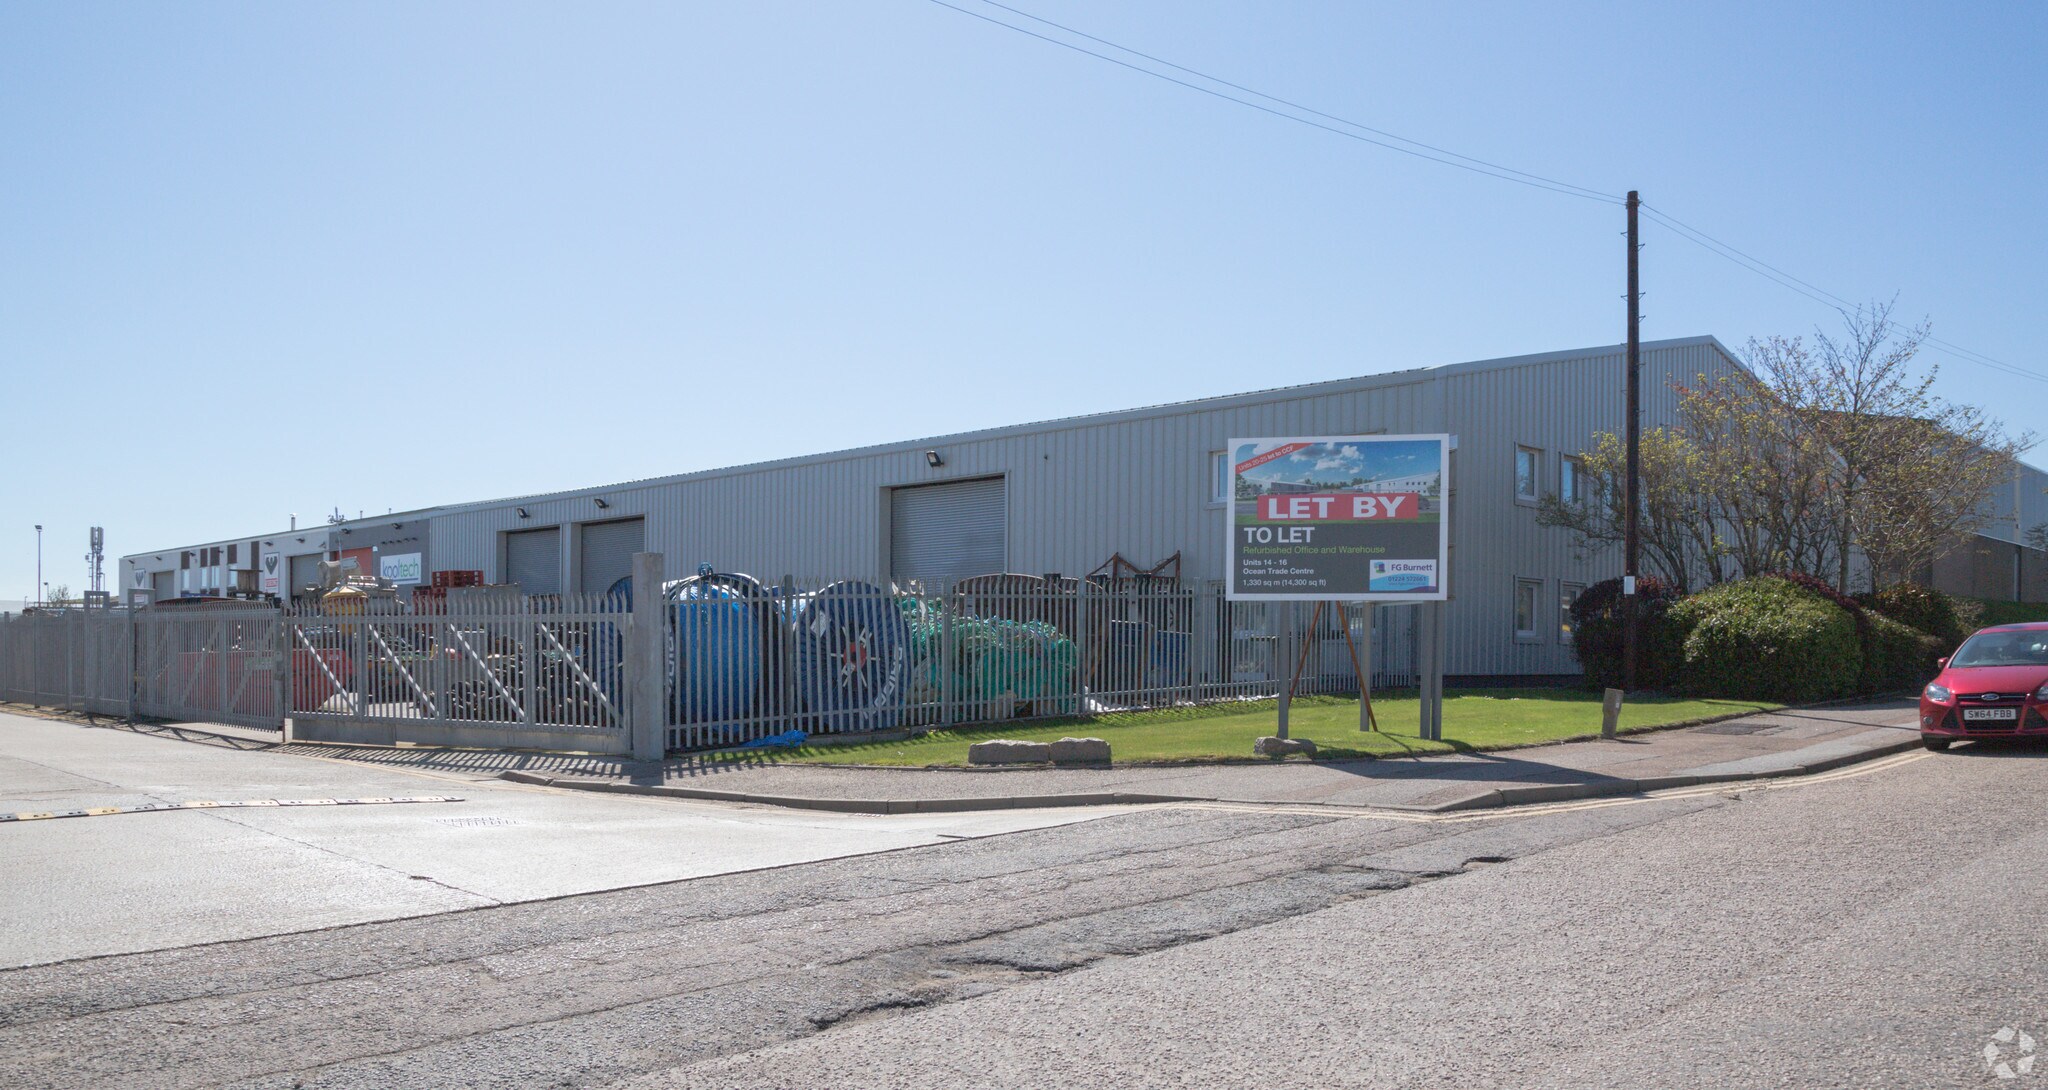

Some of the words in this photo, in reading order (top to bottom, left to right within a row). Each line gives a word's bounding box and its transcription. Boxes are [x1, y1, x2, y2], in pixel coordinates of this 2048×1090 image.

[1268, 497, 1335, 519] LET
[1353, 496, 1406, 518] BY
[1243, 527, 1272, 543] TO
[1277, 526, 1315, 543] LET
[1243, 546, 1291, 554] Refurbished
[1294, 546, 1318, 554] Office
[1320, 546, 1336, 554] and
[1338, 546, 1386, 554] Warehouse
[382, 558, 419, 578] kooltech
[1319, 579, 1327, 587] ft)
